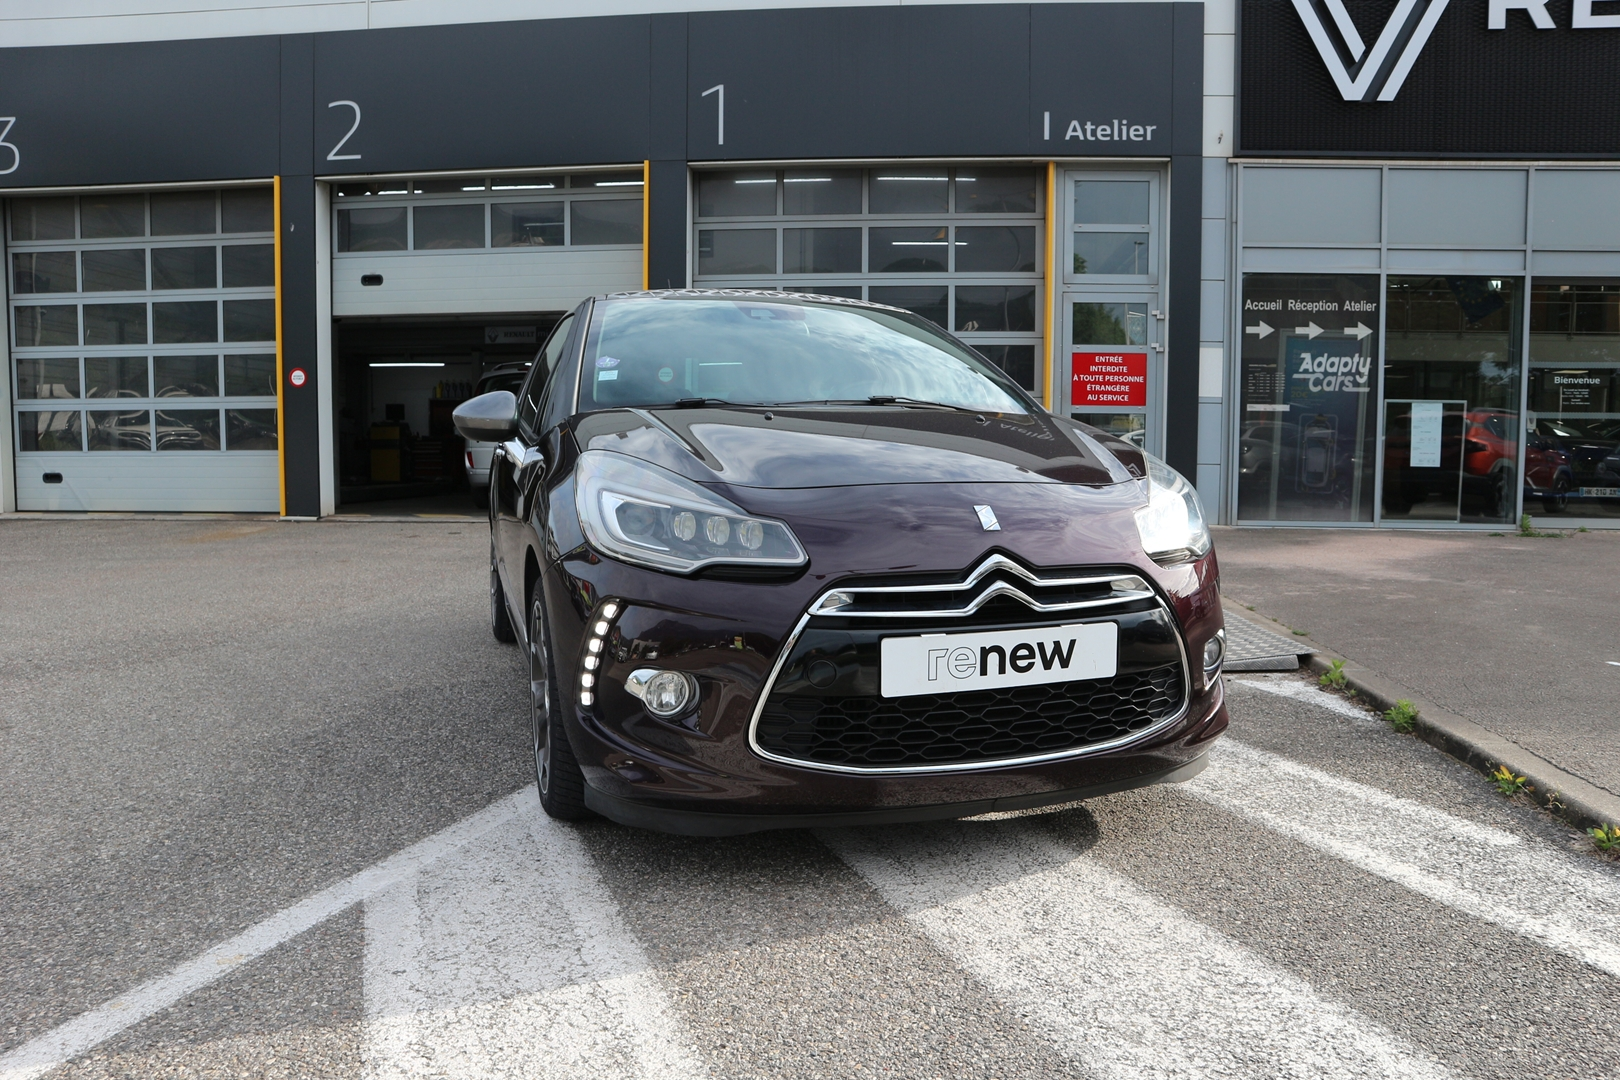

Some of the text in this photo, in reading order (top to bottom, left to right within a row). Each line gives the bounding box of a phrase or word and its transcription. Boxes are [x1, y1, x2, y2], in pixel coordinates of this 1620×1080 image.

[701, 84, 725, 145] 1
[326, 100, 362, 161] 2
[1064, 119, 1157, 141] Atelier
[0, 116, 21, 175] 3
[1244, 299, 1376, 313] Accueil Réception Atelier
[1095, 355, 1123, 363] ENTRÉE
[1089, 365, 1128, 373] INTERDITE
[1299, 352, 1371, 383] Adapty
[1080, 374, 1104, 382] TOUTE
[1105, 375, 1144, 383] PERSONNE
[1292, 373, 1370, 392] Cars
[1554, 376, 1601, 385] Bienvenue
[1086, 383, 1130, 392] ÉTRANGÈRE
[1099, 394, 1129, 402] SERVICE
[927, 638, 1077, 682] renew
